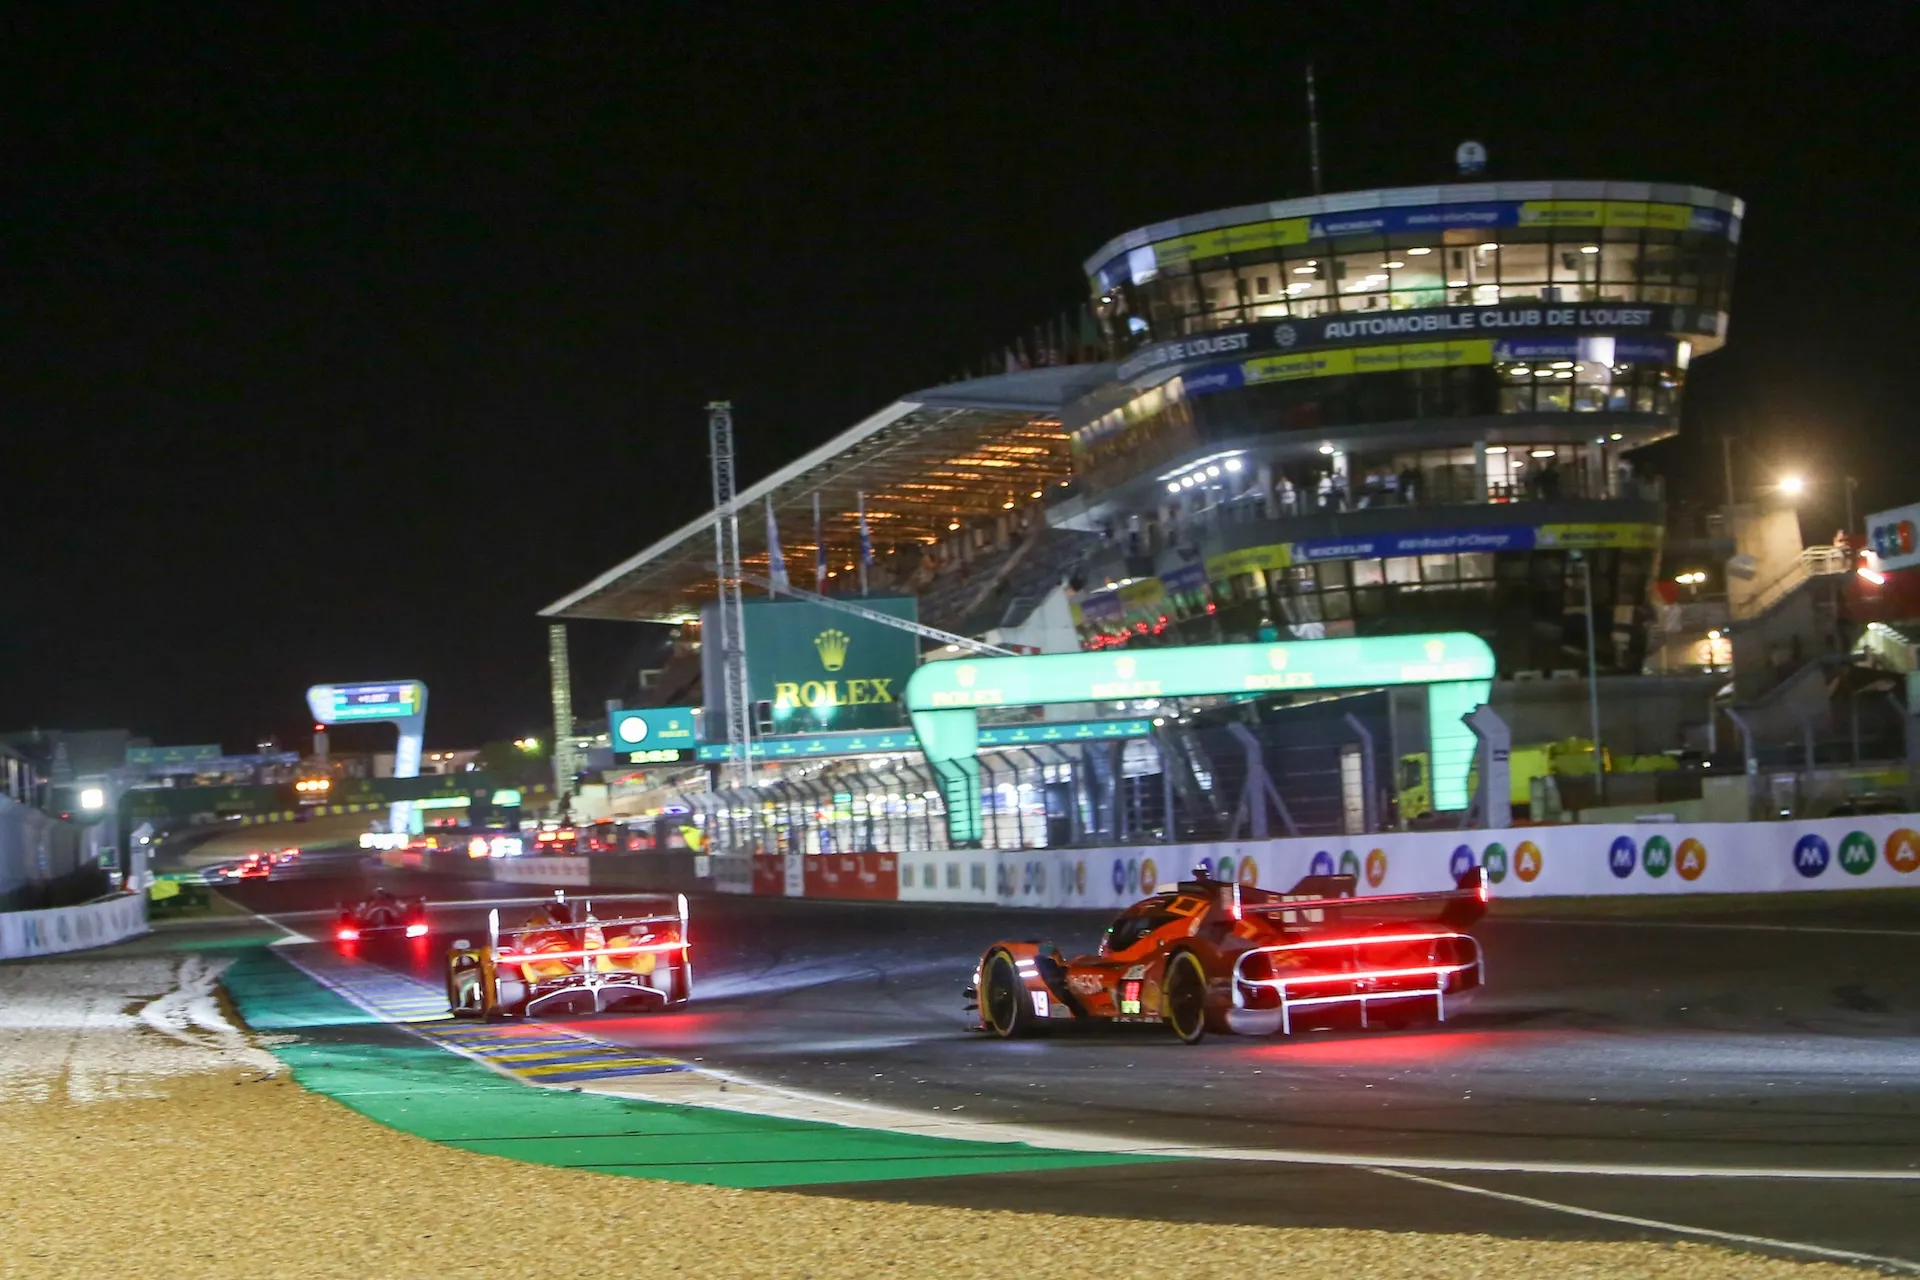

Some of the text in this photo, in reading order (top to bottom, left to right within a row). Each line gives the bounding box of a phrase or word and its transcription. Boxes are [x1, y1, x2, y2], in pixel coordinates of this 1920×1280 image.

[1323, 308, 1654, 339] AUTOMOBILE CLUB DE L'OUEST
[773, 678, 894, 709] ROLEX
